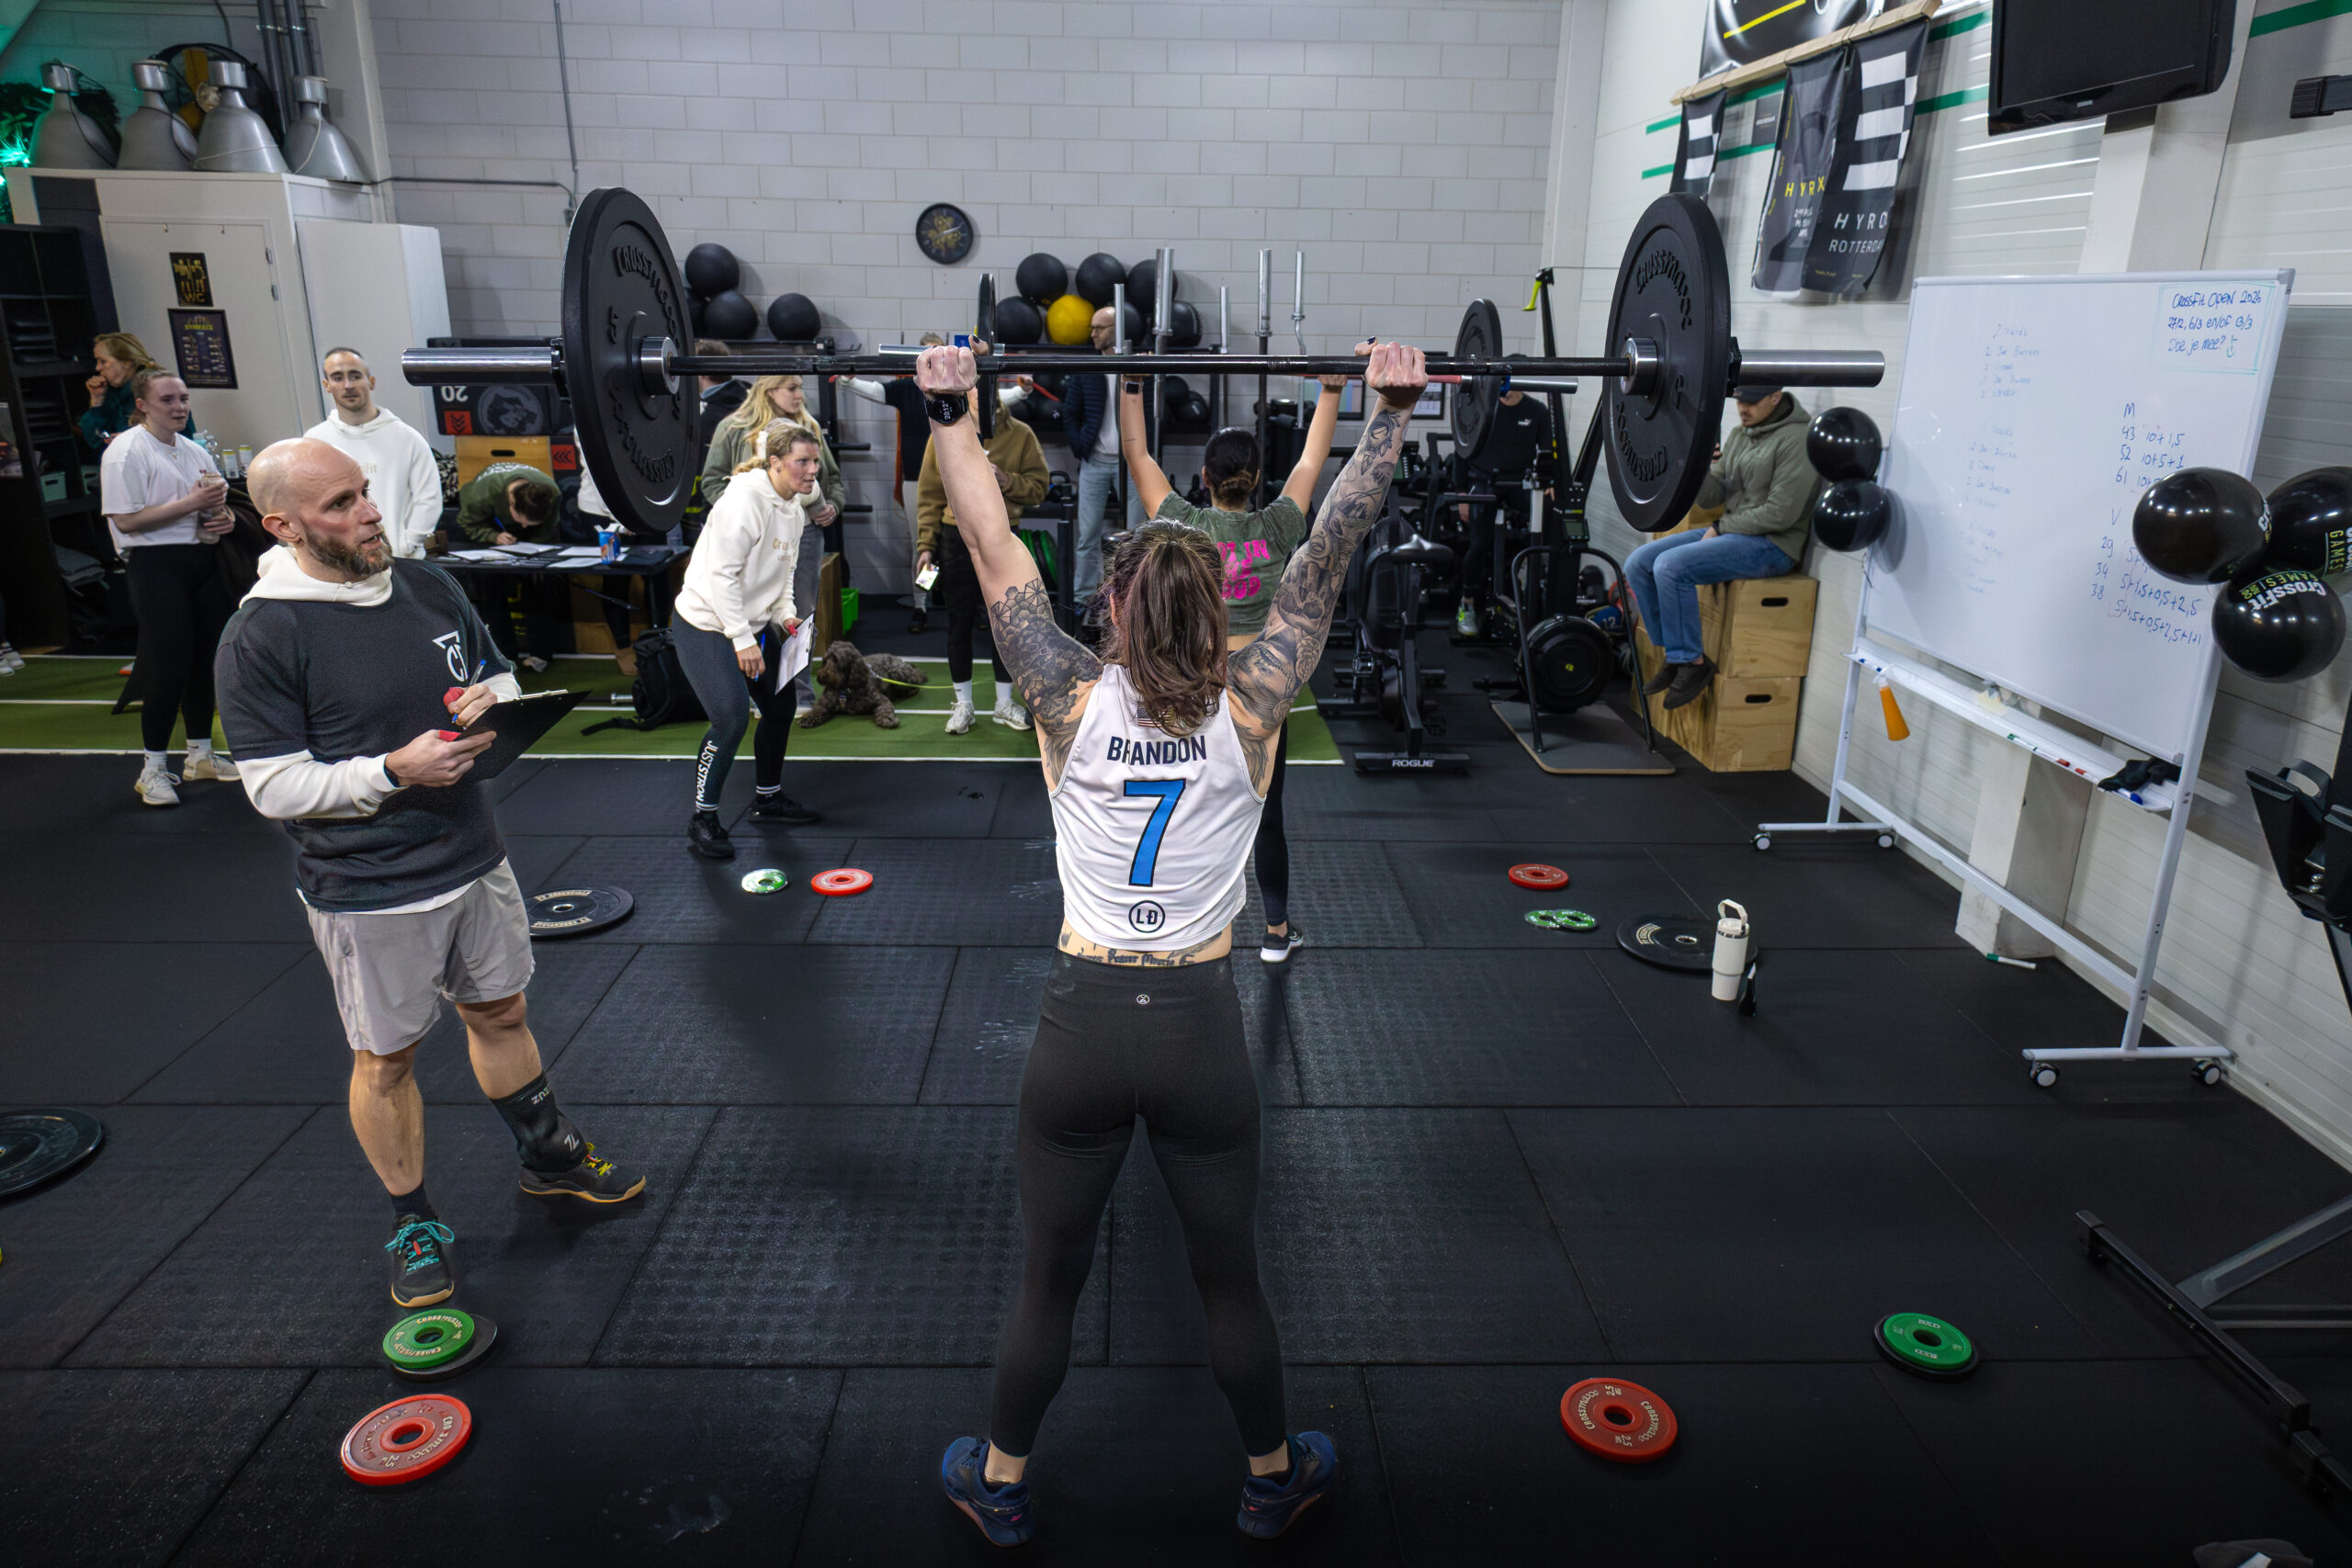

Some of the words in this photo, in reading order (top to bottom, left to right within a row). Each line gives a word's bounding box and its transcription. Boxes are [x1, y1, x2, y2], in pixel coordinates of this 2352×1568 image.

[185, 293, 205, 302] WC
[2123, 402, 2135, 419] M
[2121, 426, 2136, 441] 43
[2120, 444, 2132, 461] 52
[2116, 466, 2127, 484] 61
[1243, 539, 1271, 559] IN
[2329, 530, 2346, 570] GAMES
[2247, 581, 2327, 612] CrossFit
[1106, 735, 1207, 765] BRANDON
[1392, 759, 1434, 768] ROGUE
[1123, 778, 1186, 887] 7
